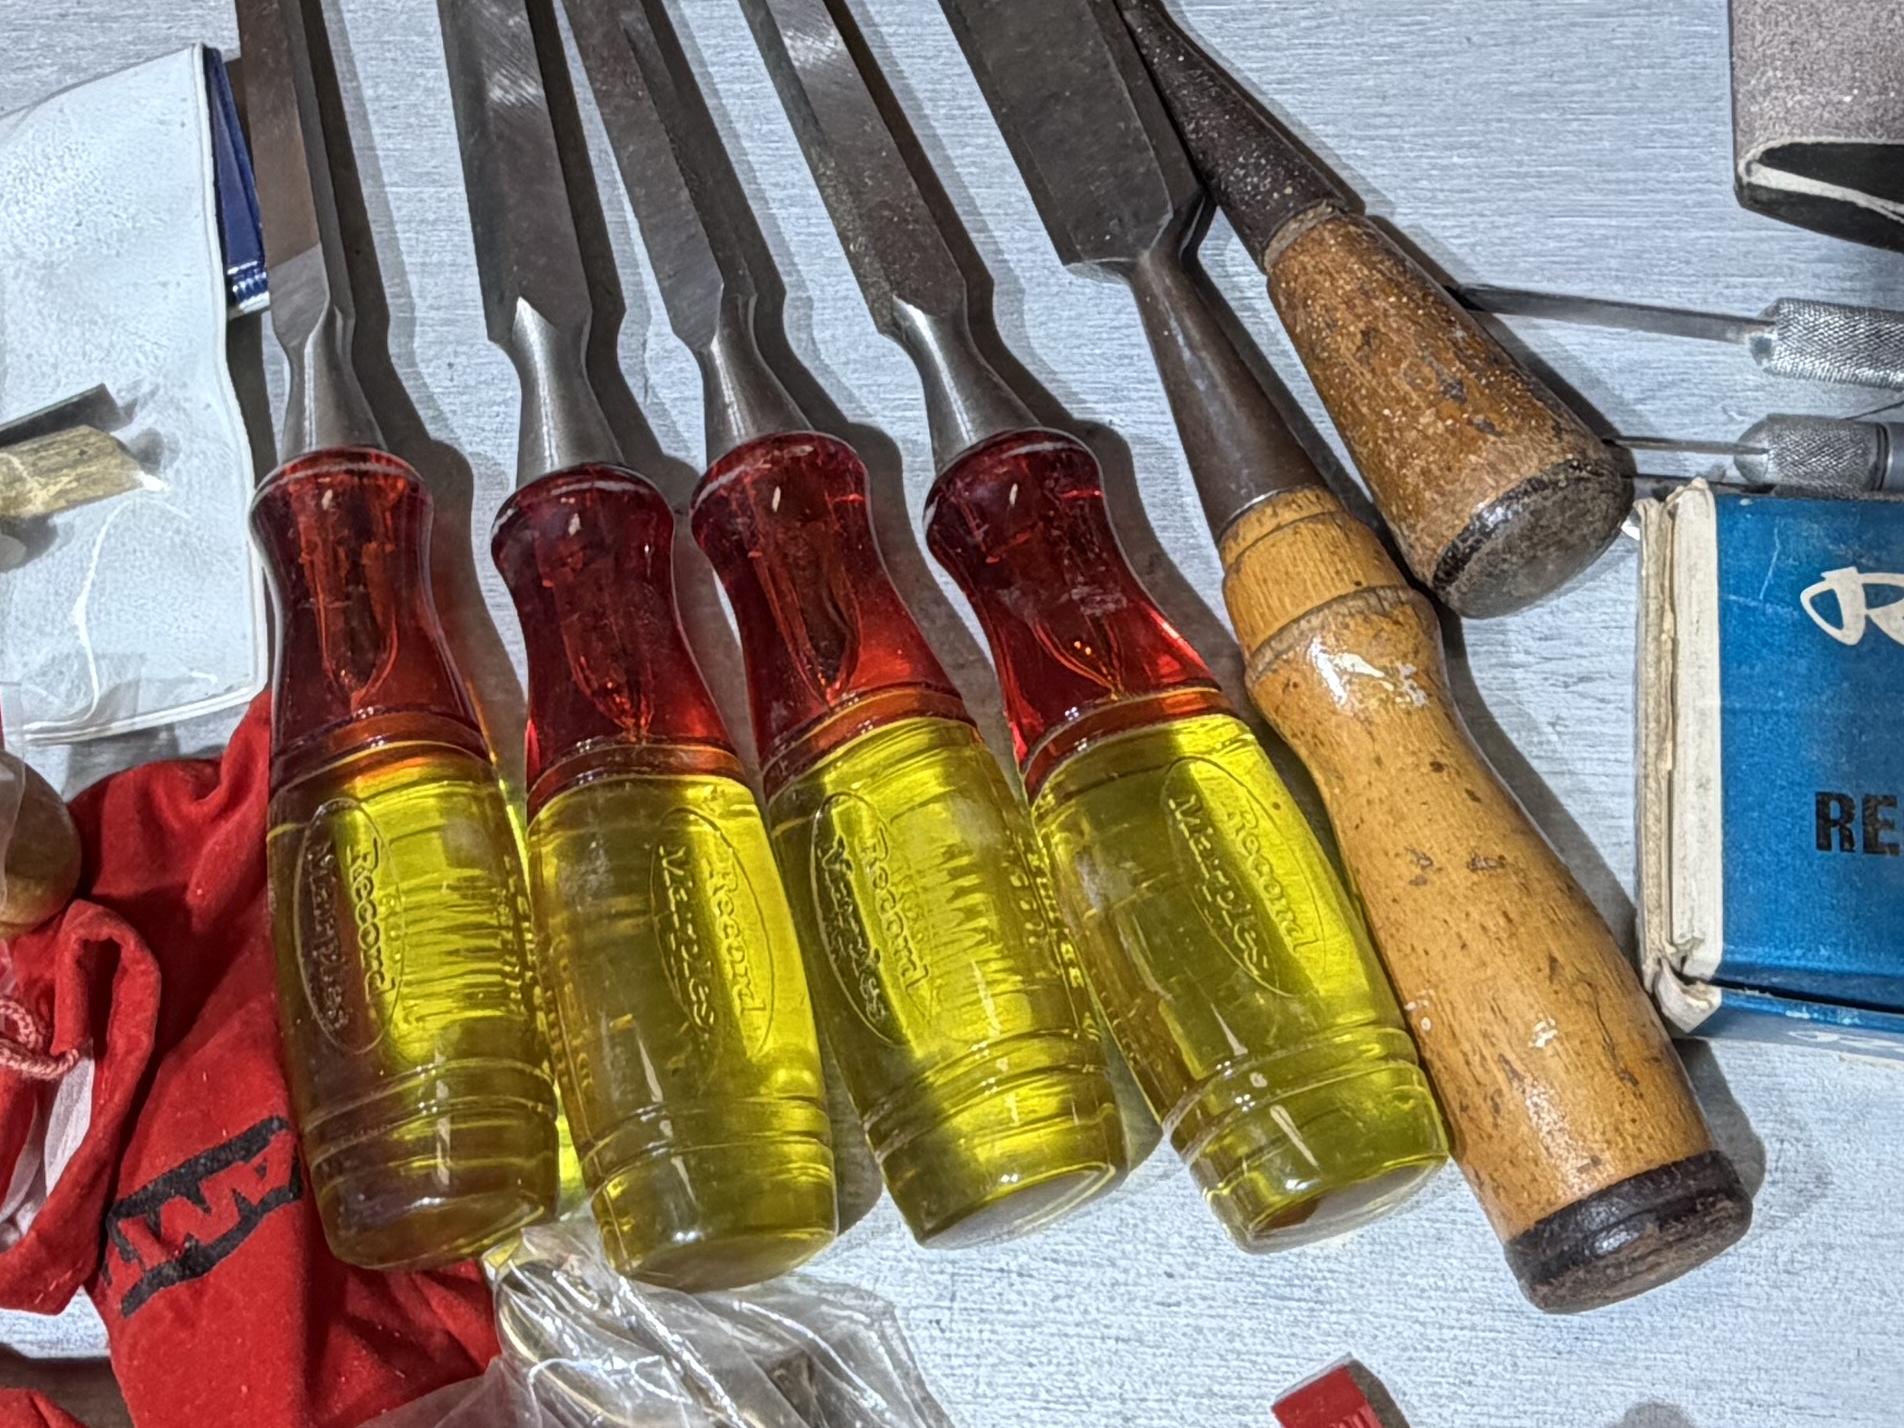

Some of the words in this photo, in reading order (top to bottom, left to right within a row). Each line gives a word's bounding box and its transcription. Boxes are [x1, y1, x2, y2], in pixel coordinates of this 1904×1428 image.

[347, 837, 396, 1004] Record
[701, 850, 767, 1016] Record
[853, 826, 929, 992] Record
[1227, 798, 1320, 952] Record
